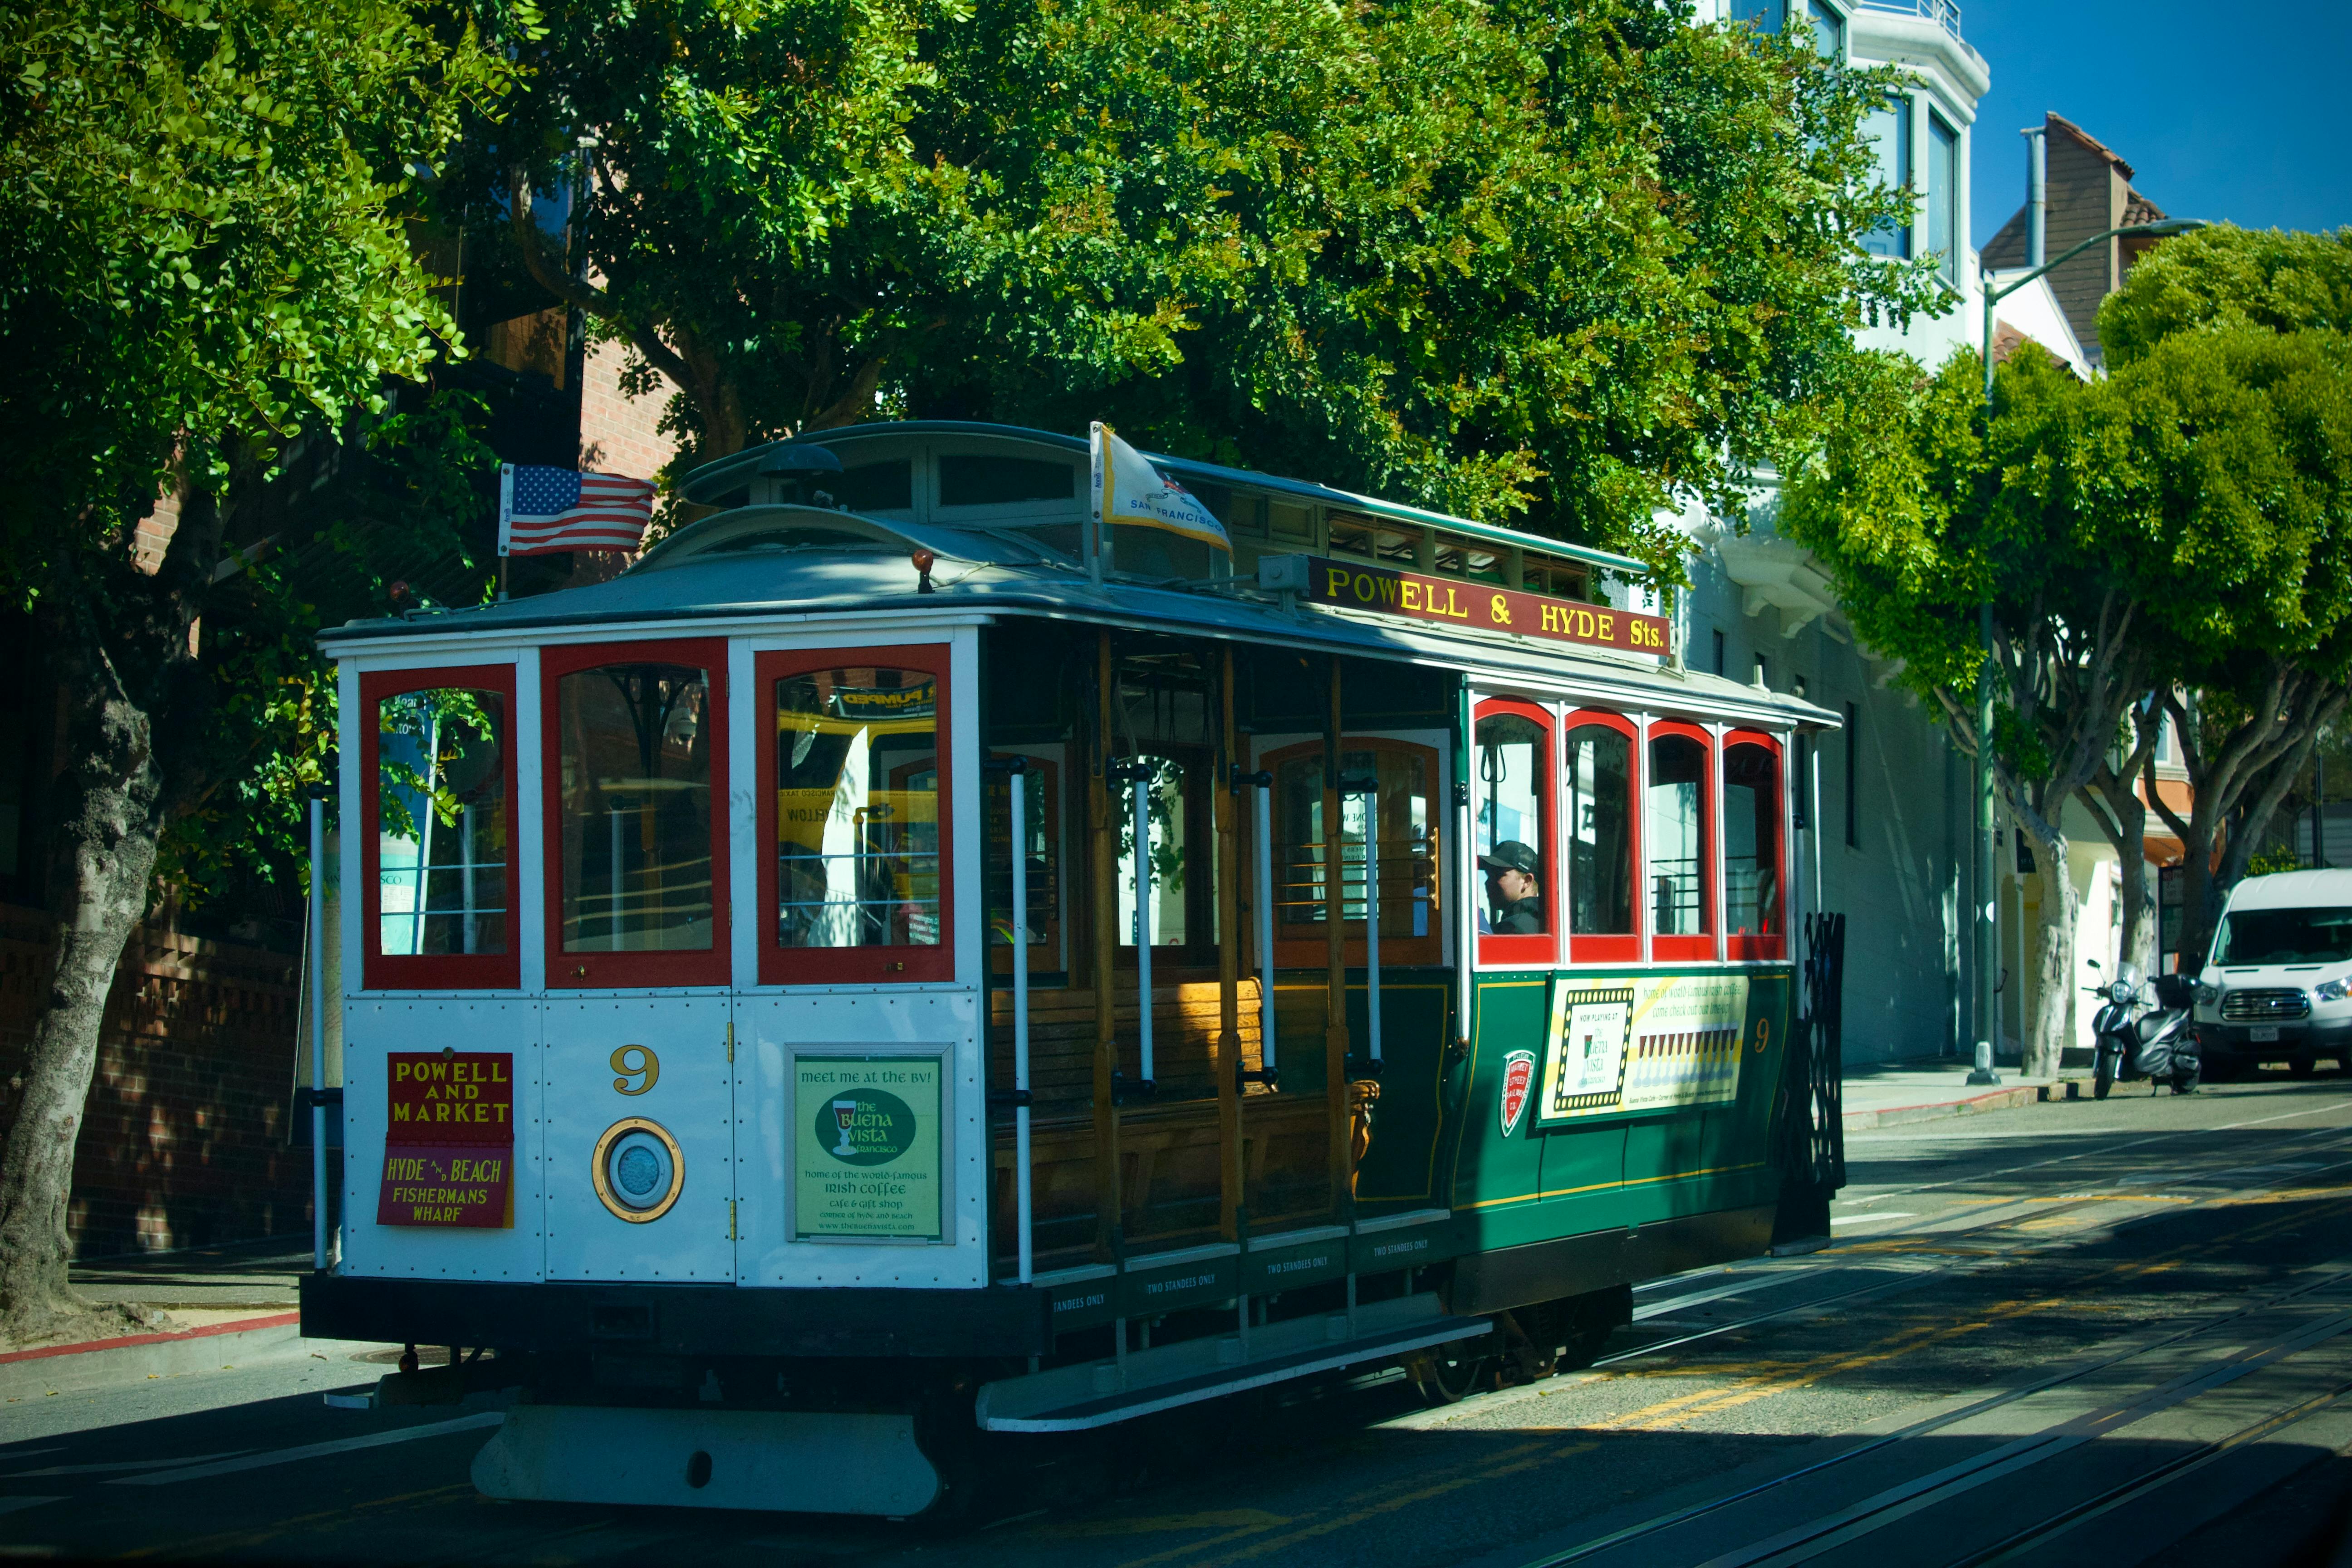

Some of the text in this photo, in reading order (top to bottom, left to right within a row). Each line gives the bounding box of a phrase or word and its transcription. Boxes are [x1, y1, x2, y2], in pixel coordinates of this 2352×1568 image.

[1130, 500, 1222, 532] SAN FRANCISCO
[1327, 568, 1664, 647] POWELL & HYDE Sts.
[1643, 987, 1659, 1000] home
[1661, 987, 1668, 1000] of
[1592, 1013, 1611, 1022] PLAYING
[1652, 1007, 1668, 1018] come
[1670, 1004, 1686, 1017] check
[1687, 1004, 1697, 1016] out
[1754, 1017, 1769, 1054] 9
[396, 1062, 507, 1083] POWELL
[609, 1044, 660, 1096] 9
[1510, 1063, 1528, 1073] MARKET
[801, 1071, 931, 1083] meet me at the BV!
[1509, 1076, 1526, 1086] STREET
[424, 1084, 479, 1100] AND
[1507, 1089, 1525, 1098] RAILWAY
[393, 1103, 509, 1122] MARKET
[857, 1101, 876, 1112] the
[387, 1158, 501, 1183] HYDE AND BEACH
[805, 1170, 830, 1179] home
[832, 1171, 843, 1179] of
[844, 1170, 859, 1179] the
[392, 1187, 488, 1205] FISHERMANS
[829, 1200, 850, 1209] cafe
[851, 1200, 858, 1208] &
[879, 1200, 903, 1210] shop
[413, 1207, 463, 1222] WHARF
[1374, 1239, 1428, 1256] TWO STANDEES ONLY
[1267, 1256, 1328, 1274] TWO STANDEES ONLY
[1148, 1274, 1215, 1294] TWO STANDEES ONLY
[1086, 1294, 1104, 1306] ONLY
